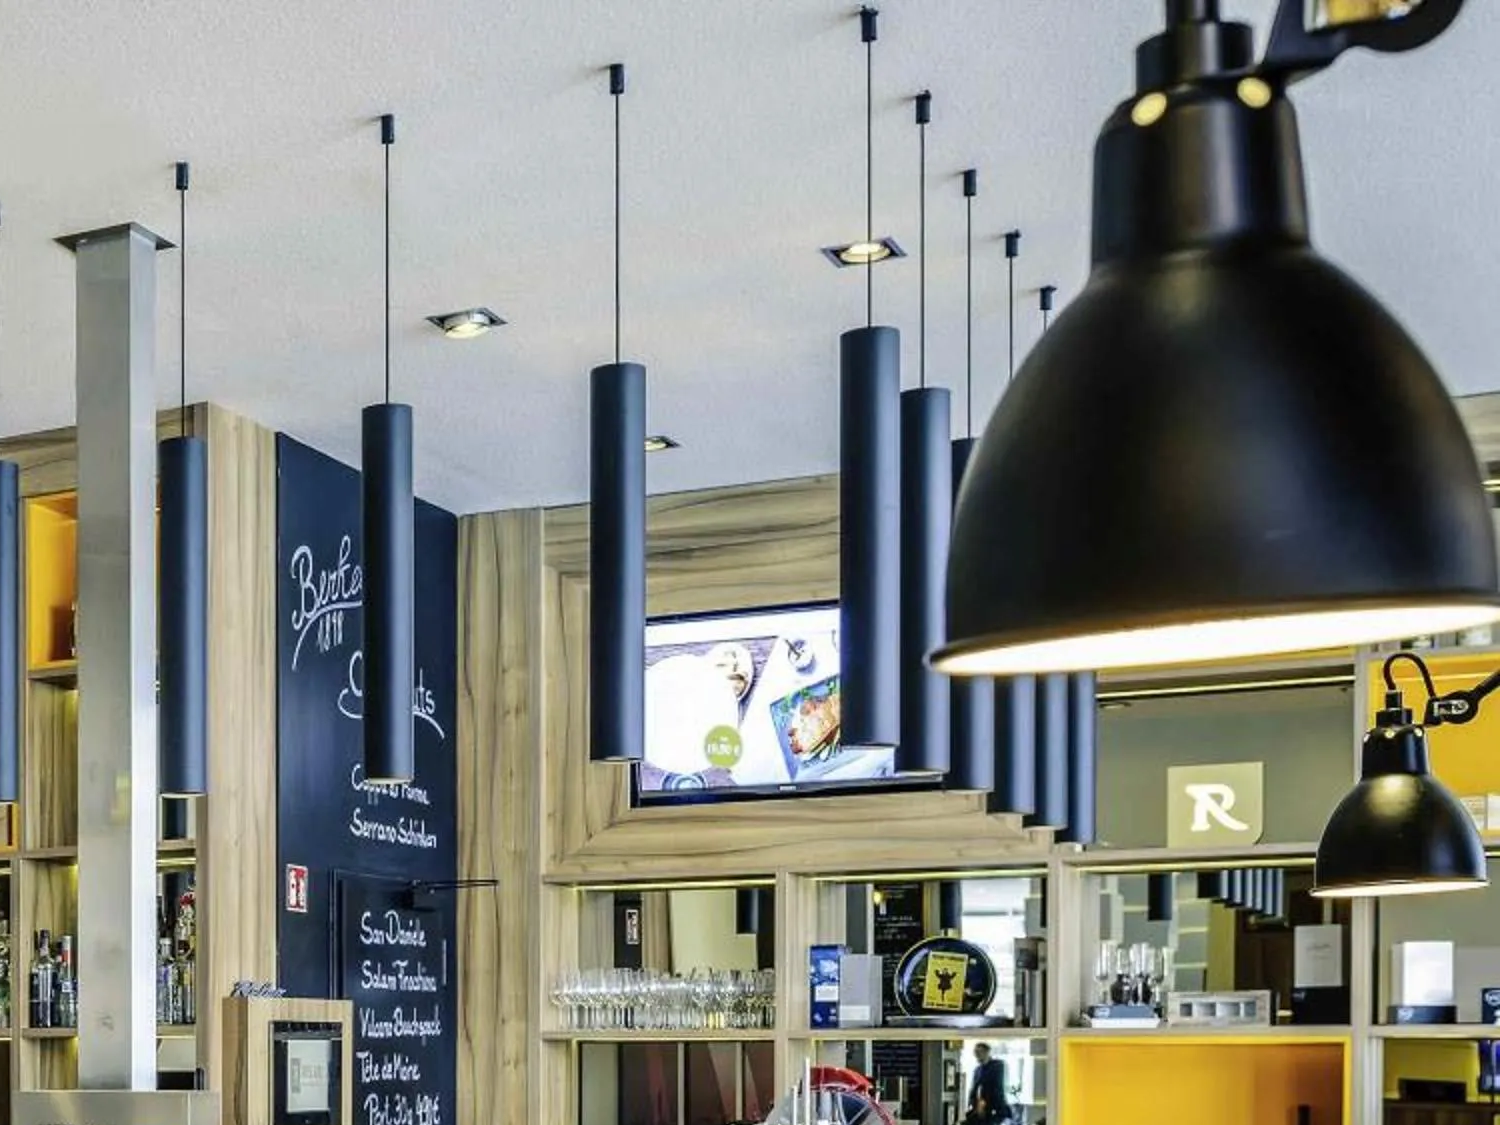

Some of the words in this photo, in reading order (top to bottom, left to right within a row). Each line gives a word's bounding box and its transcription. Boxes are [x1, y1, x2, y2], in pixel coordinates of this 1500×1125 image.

[292, 535, 362, 630] Berke
[1185, 783, 1250, 833] R
[360, 910, 384, 945] San
